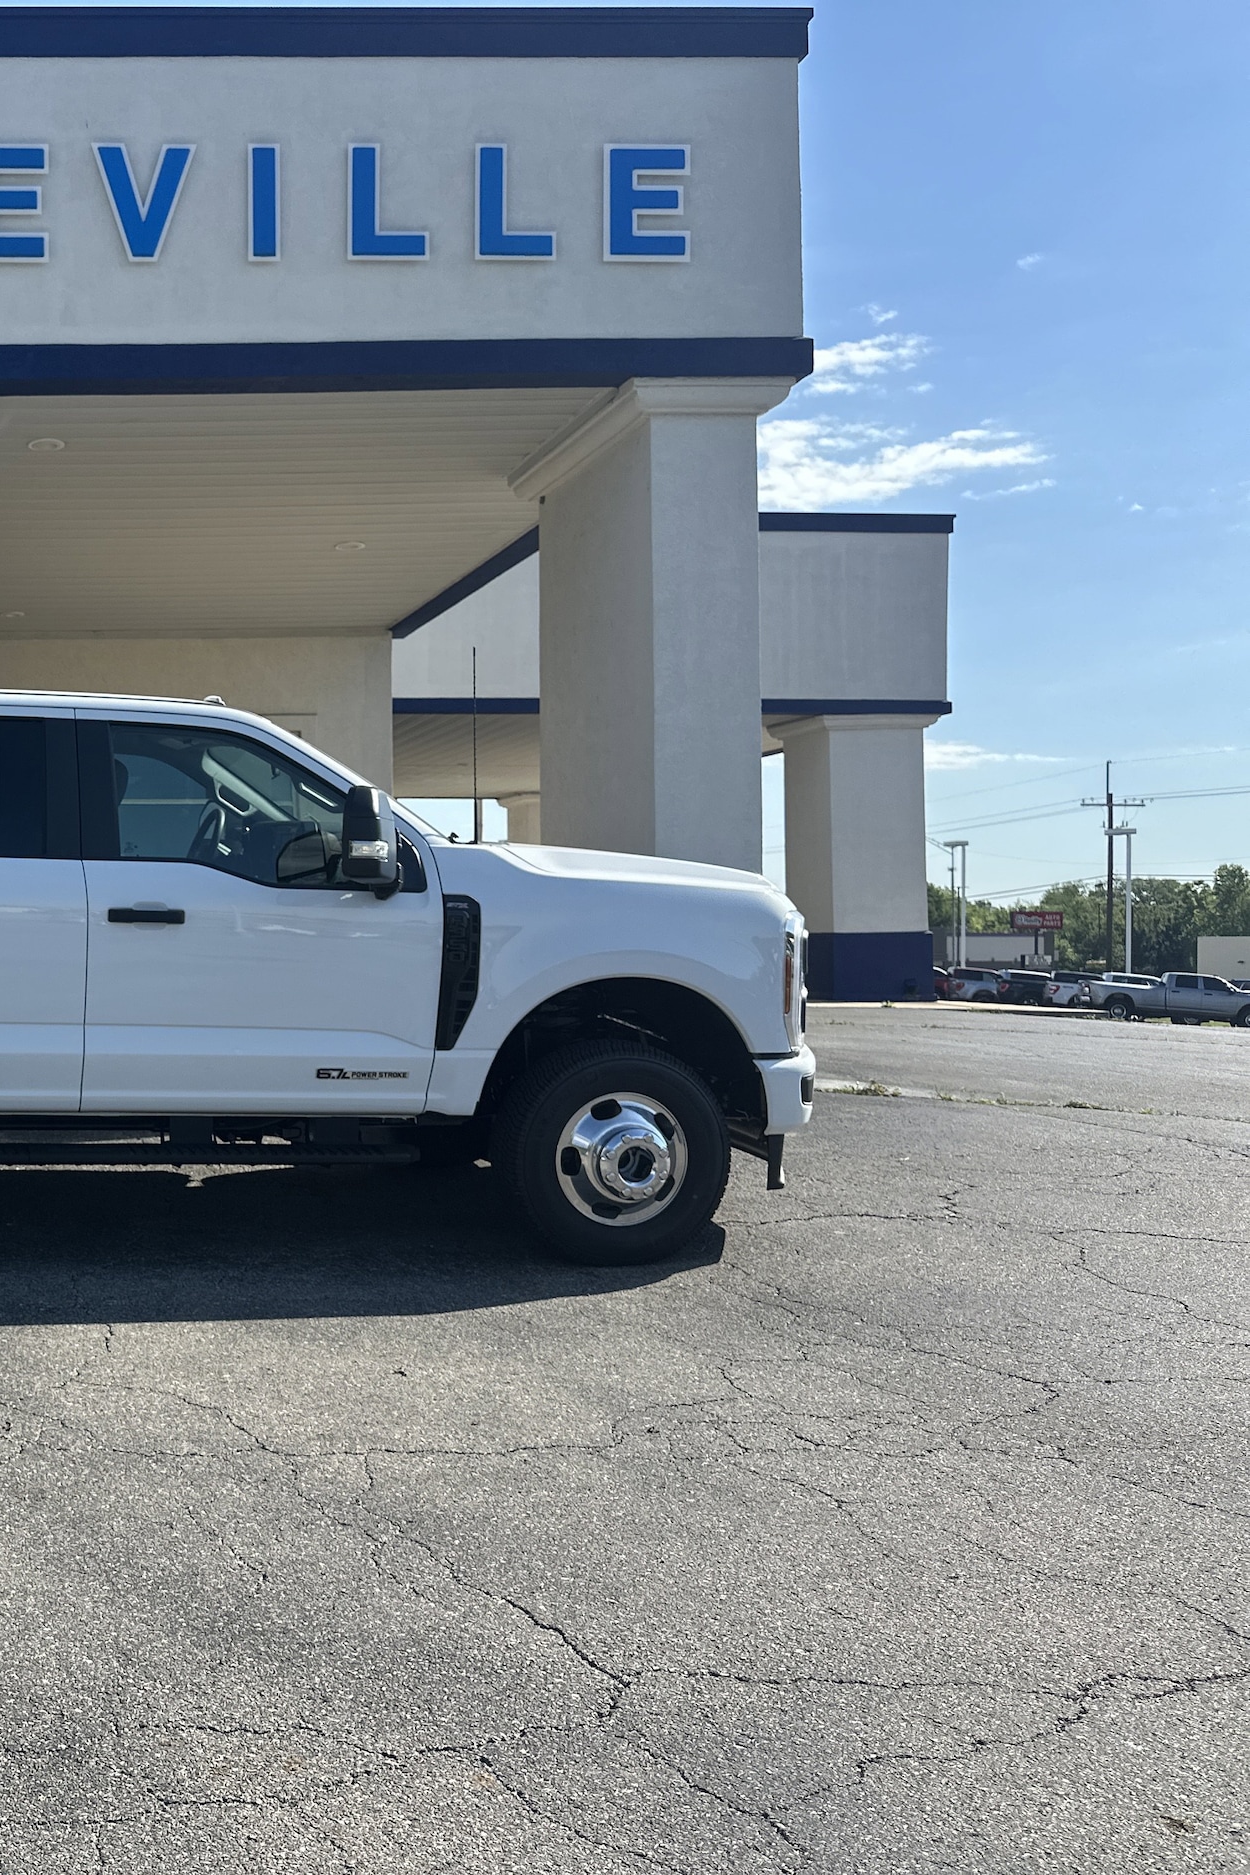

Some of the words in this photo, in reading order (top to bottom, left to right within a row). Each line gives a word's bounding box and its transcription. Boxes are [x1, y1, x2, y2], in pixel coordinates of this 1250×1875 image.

[316, 1068, 350, 1080] 6.7L
[351, 1071, 377, 1079] POWER
[378, 1071, 408, 1079] STROKE
